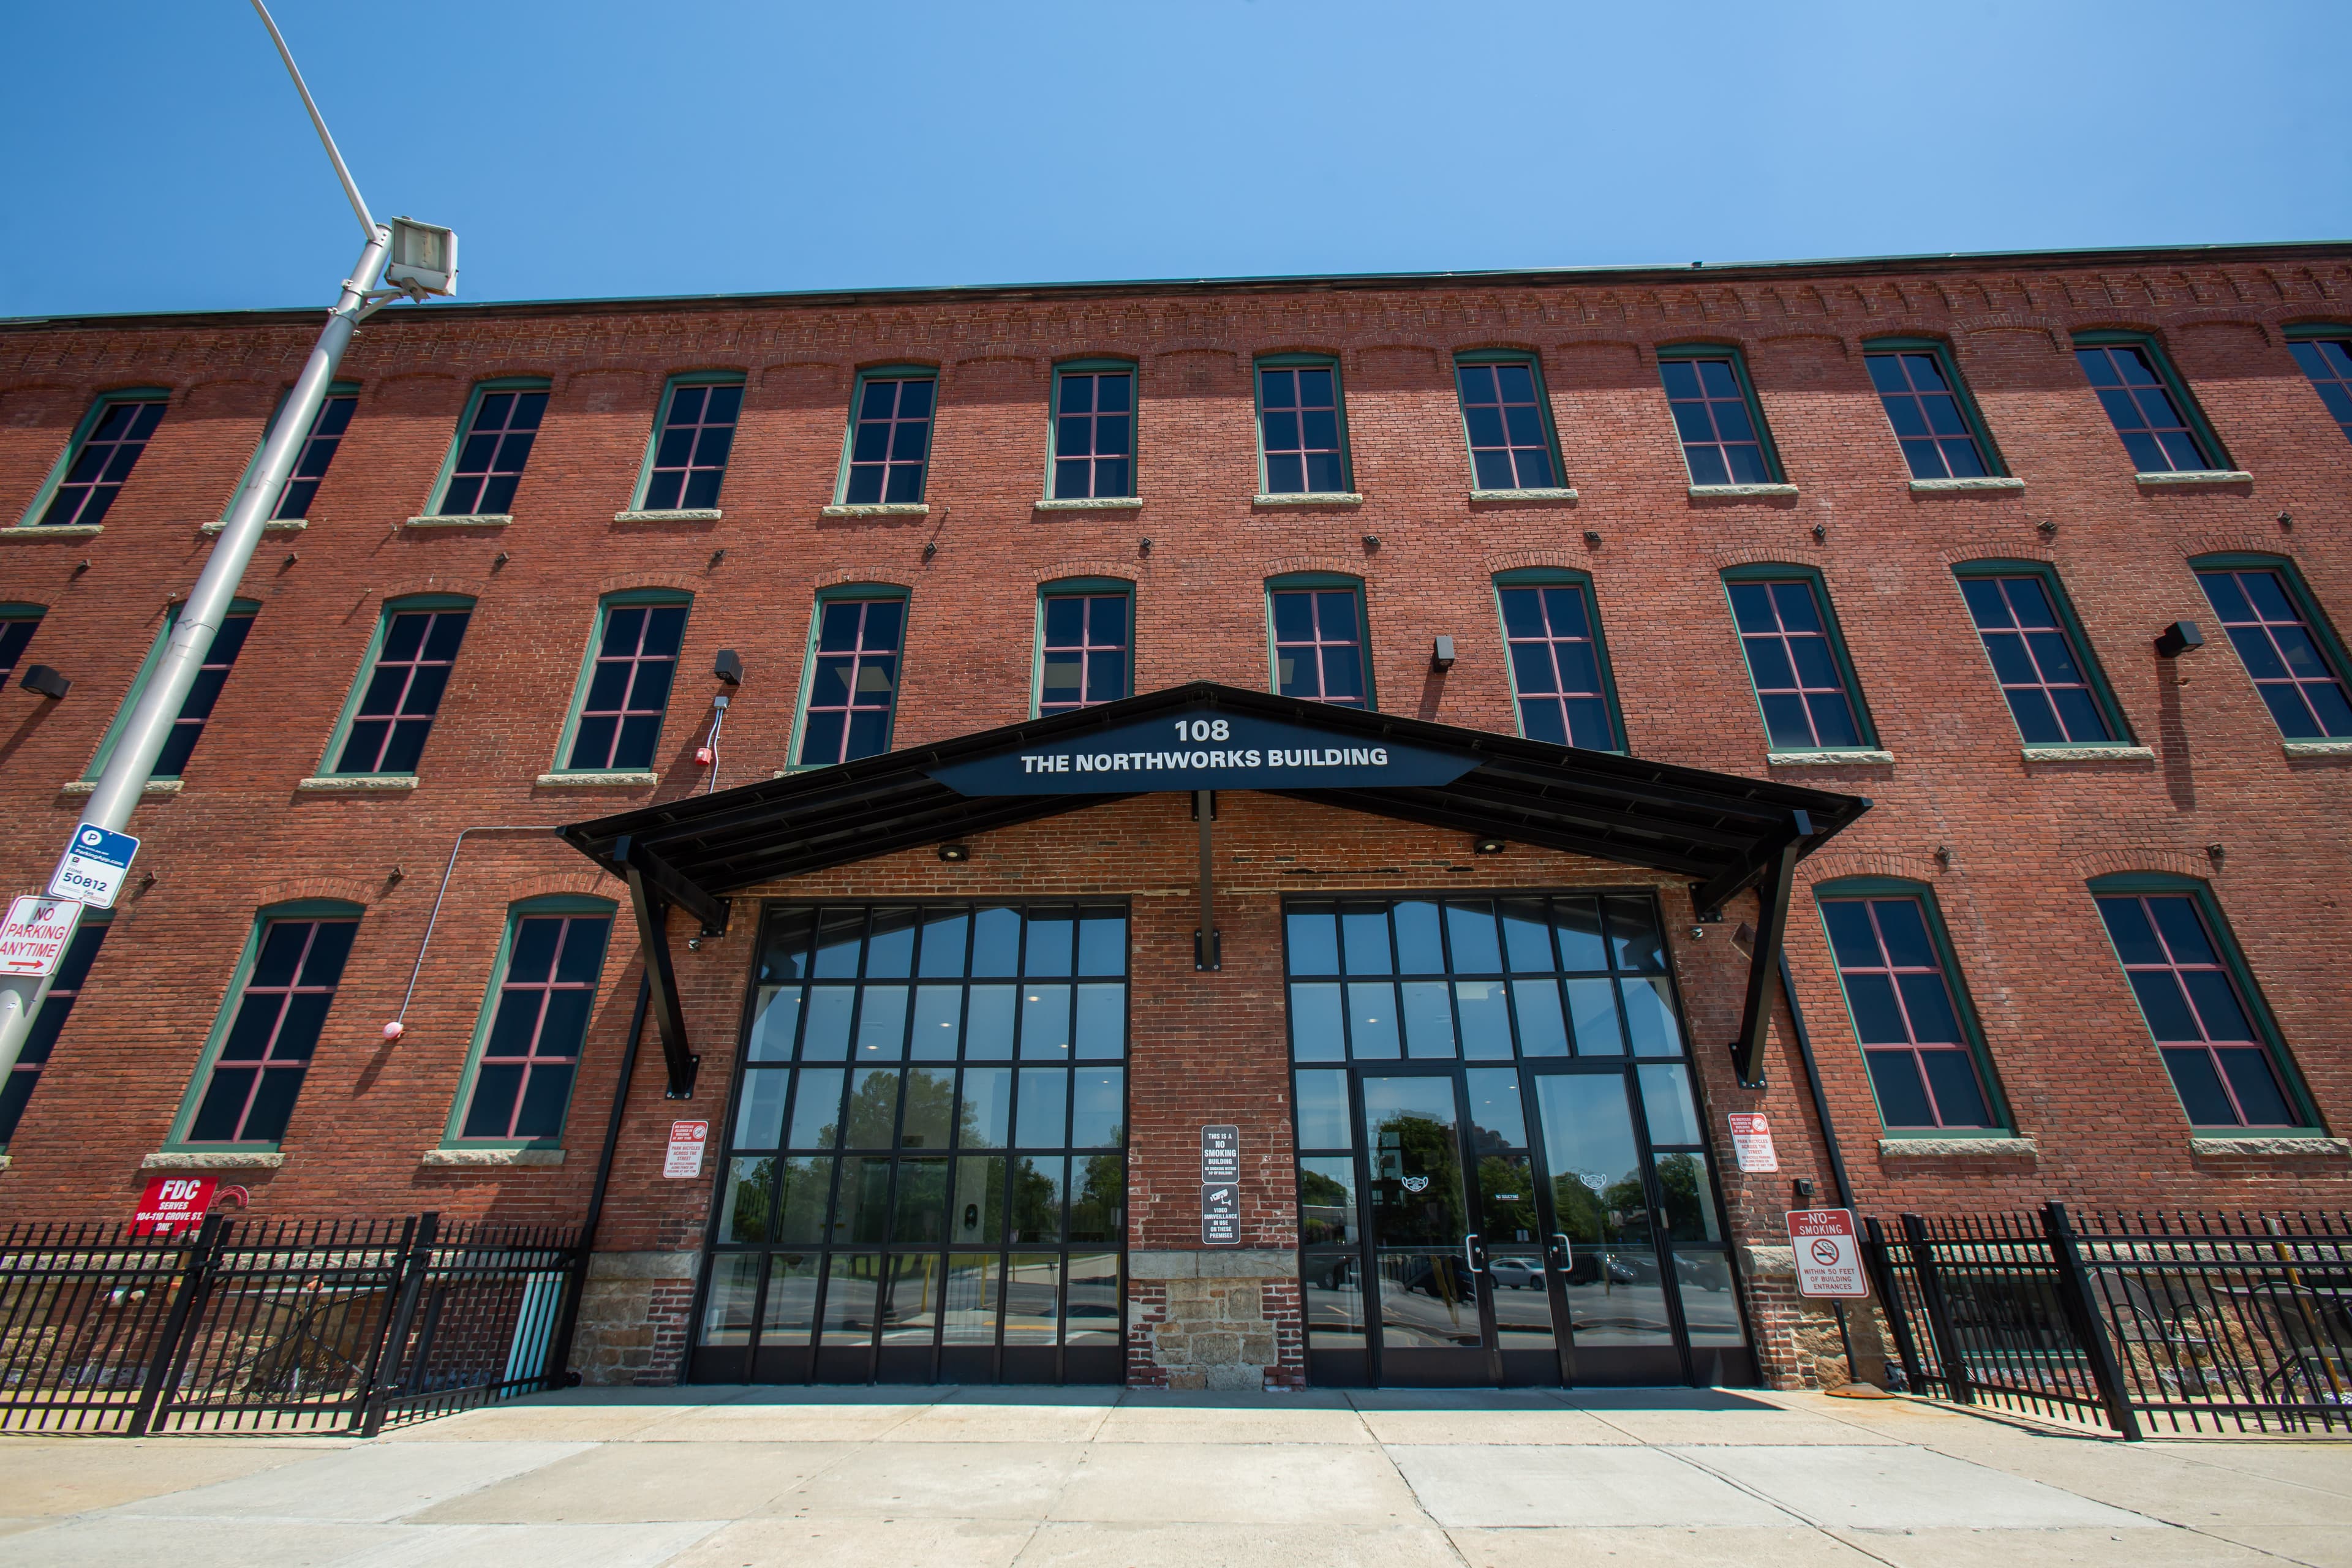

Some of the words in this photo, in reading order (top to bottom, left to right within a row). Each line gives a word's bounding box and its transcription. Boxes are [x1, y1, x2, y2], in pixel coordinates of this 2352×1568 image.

[1175, 720, 1229, 741] 108
[1022, 755, 1069, 772] THE
[1077, 750, 1261, 771] NORTHWORKS
[1268, 748, 1387, 766] BUILDING
[62, 872, 107, 892] 50812
[33, 907, 55, 921] NO
[6, 923, 66, 940] PARKING
[0, 941, 58, 957] ANYTIME
[158, 1179, 201, 1200] FDC
[159, 1201, 189, 1210] SERVES
[136, 1212, 165, 1221] 104-110
[164, 1212, 192, 1221] GROVE
[190, 1212, 203, 1221] ST.
[1808, 1212, 1827, 1224] NO
[156, 1223, 173, 1231] ONL
[1799, 1224, 1842, 1235] SMOKING
